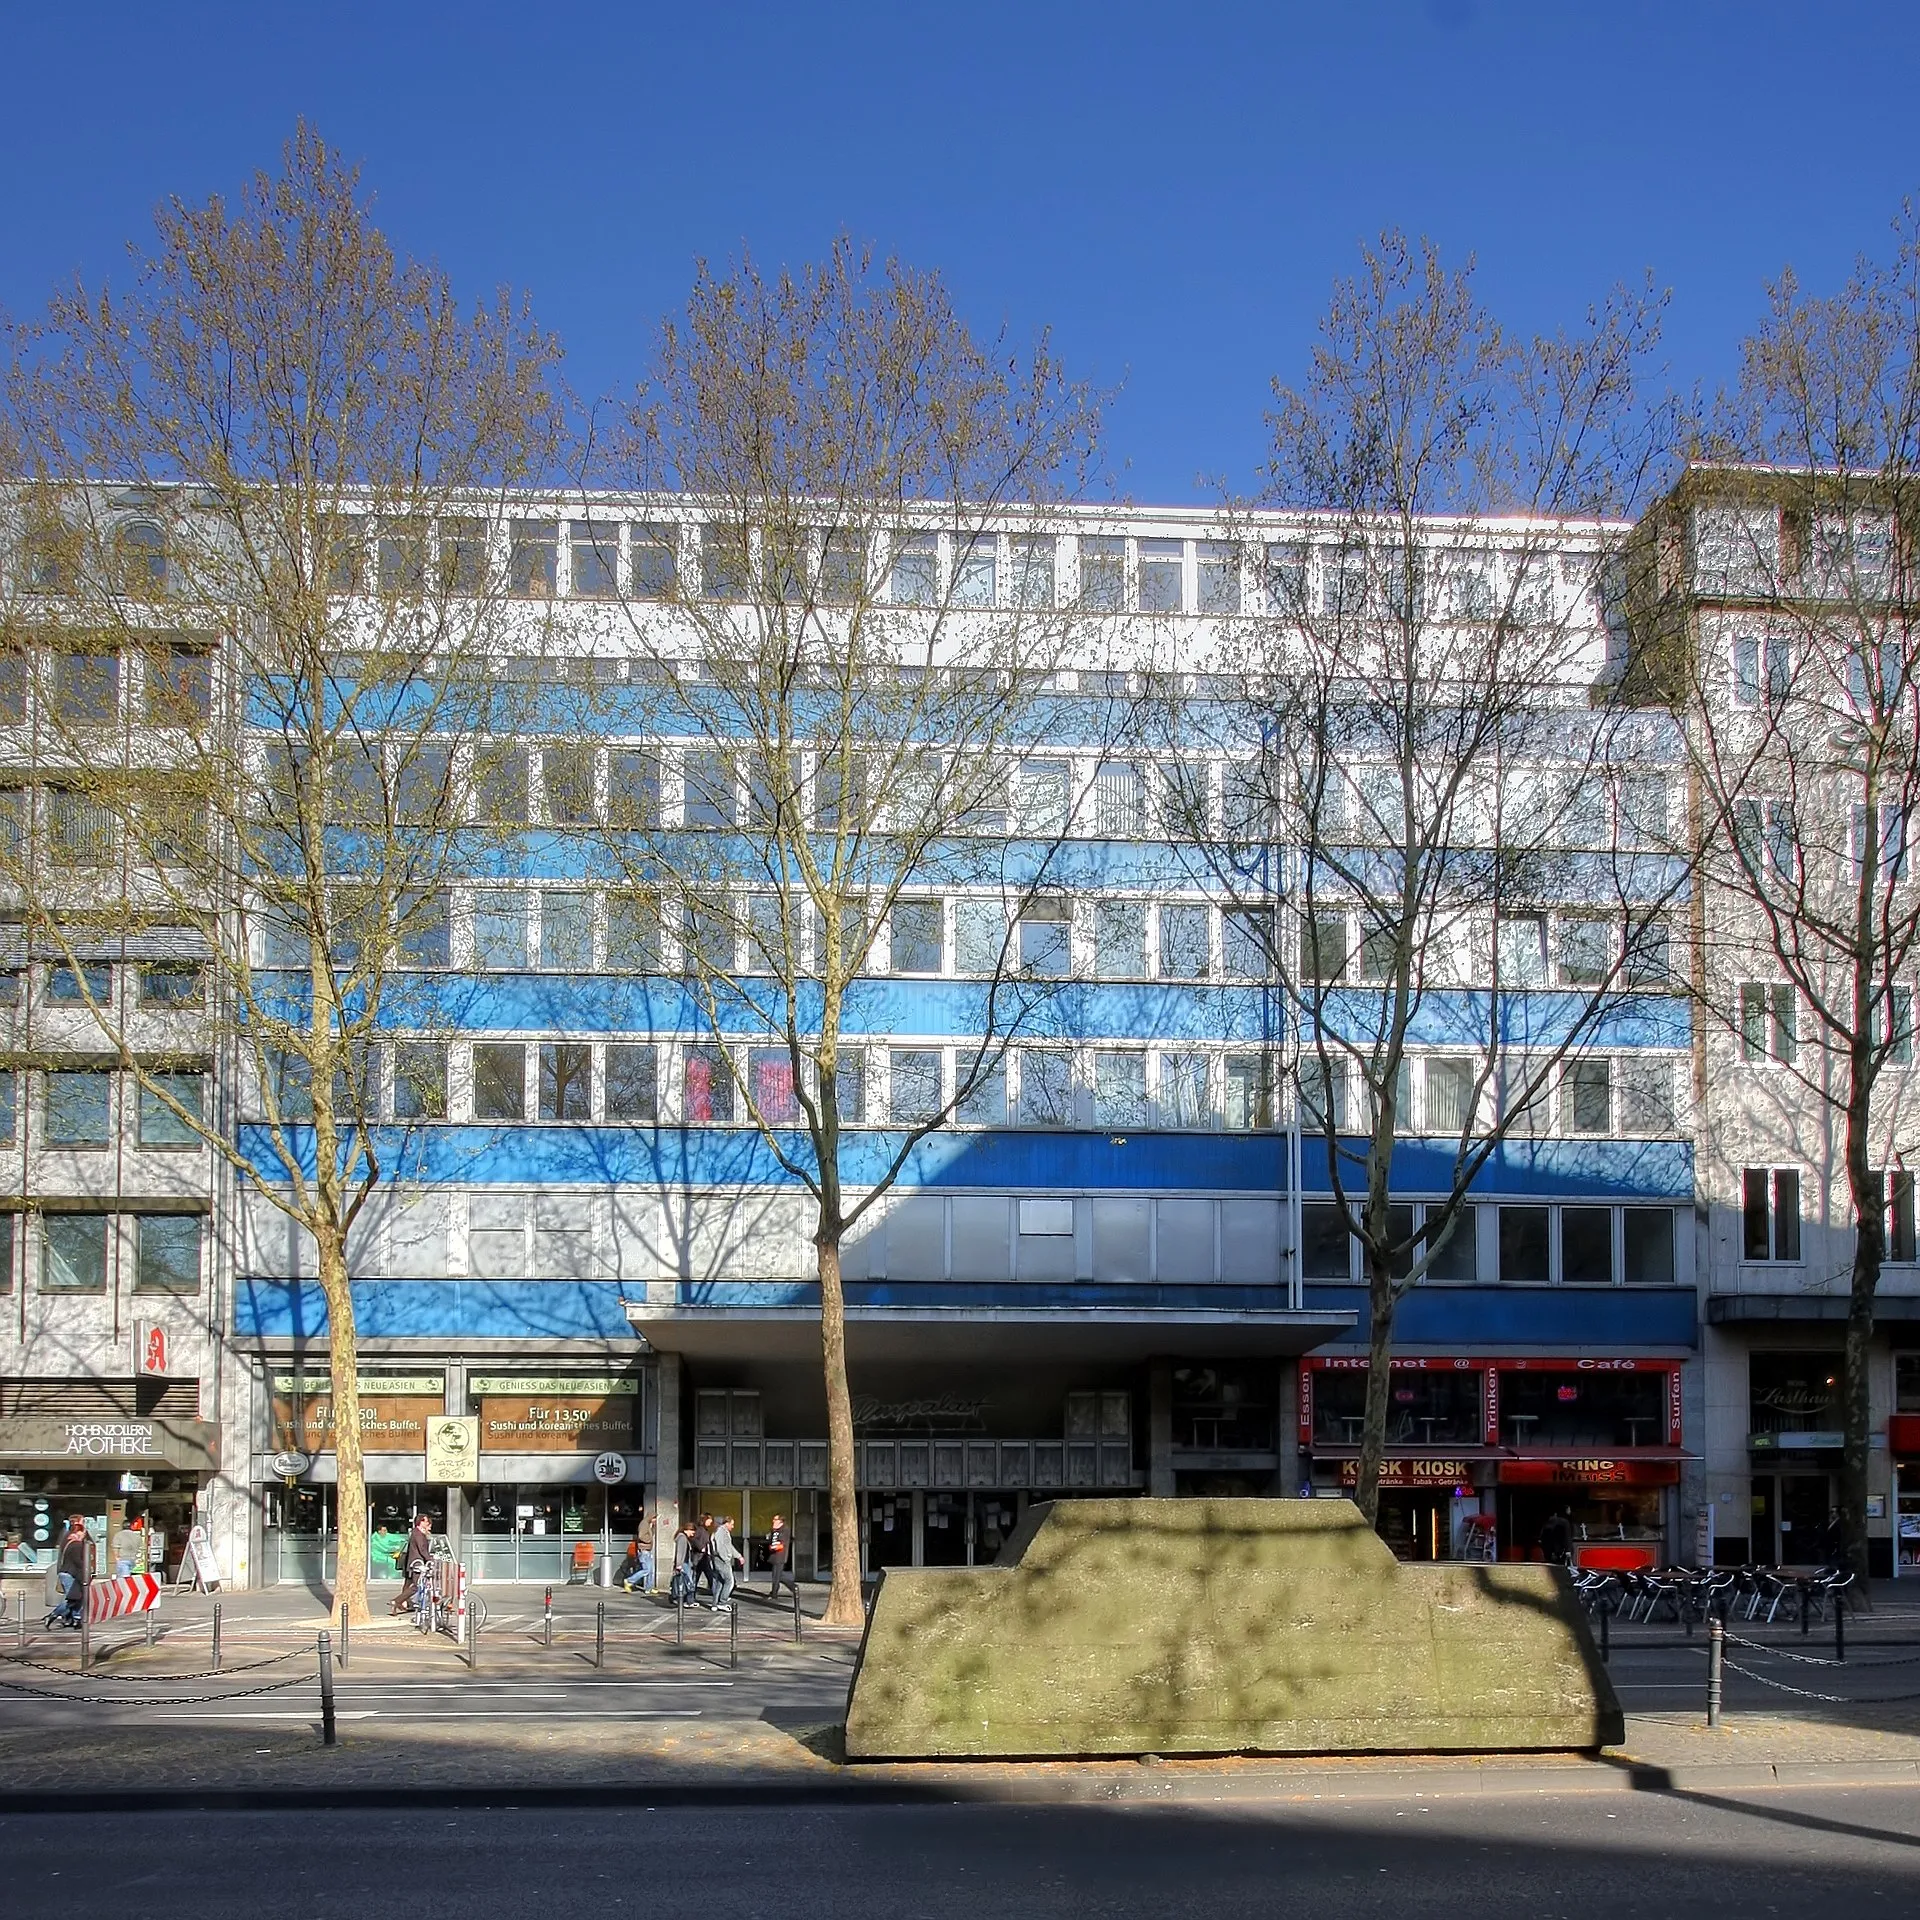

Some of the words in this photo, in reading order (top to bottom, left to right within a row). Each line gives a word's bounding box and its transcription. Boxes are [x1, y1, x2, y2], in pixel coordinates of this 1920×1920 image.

[1325, 1358, 1428, 1368] Intenet
[1577, 1358, 1636, 1369] Café
[304, 1381, 332, 1389] GENIE
[364, 1381, 387, 1390] NEUE
[389, 1381, 415, 1390] ASIEN
[499, 1381, 537, 1390] GENIESS
[540, 1381, 557, 1390] DAS
[559, 1381, 582, 1390] NEUE
[583, 1381, 610, 1390] ASIEN
[1487, 1367, 1496, 1432] Trinken
[1671, 1372, 1681, 1429] Surfen
[529, 1407, 550, 1419] Für
[554, 1409, 591, 1422] 13,50!
[65, 1424, 152, 1436] HOHENZOLLERN
[306, 1420, 324, 1429] und
[327, 1420, 388, 1430] kosches
[389, 1420, 421, 1430] Buffet.
[490, 1420, 517, 1431] Sushi
[518, 1420, 537, 1431] und
[538, 1420, 600, 1431] koreanisches
[602, 1420, 633, 1431] Buffet.
[67, 1437, 152, 1454] APOTHEKE
[1342, 1460, 1403, 1475] KSK
[1412, 1460, 1468, 1475] KIOSK
[1562, 1459, 1615, 1471] RING
